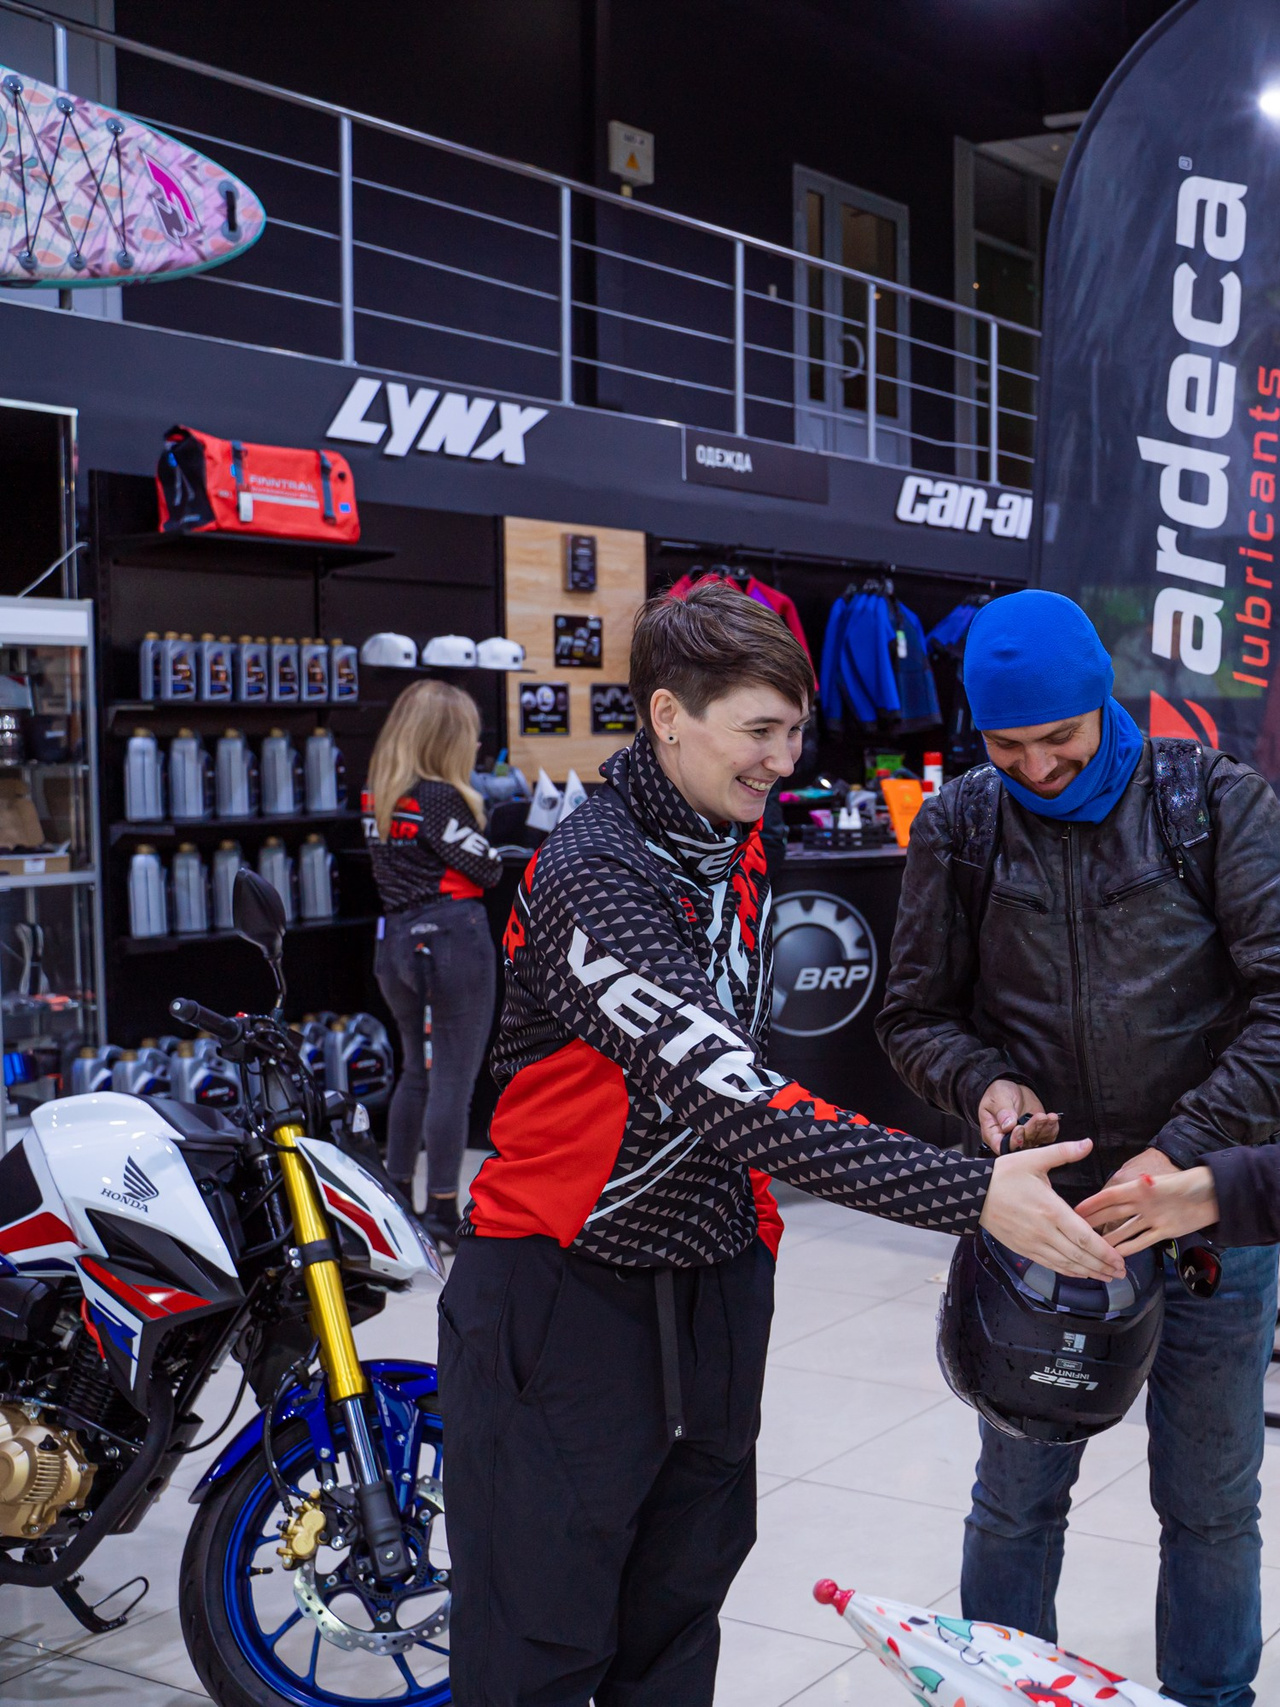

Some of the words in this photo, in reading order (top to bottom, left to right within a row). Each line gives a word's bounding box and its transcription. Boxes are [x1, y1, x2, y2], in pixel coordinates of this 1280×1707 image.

[325, 376, 549, 465] LYNX
[1136, 175, 1248, 676] ardeca
[695, 444, 753, 473] ОДЕЖДА
[249, 474, 317, 493] FINNTRAIL
[794, 964, 870, 991] BRP
[101, 1187, 149, 1213] HONDA
[1029, 1370, 1099, 1391] LS2
[1050, 1368, 1090, 1380] INFINITY
